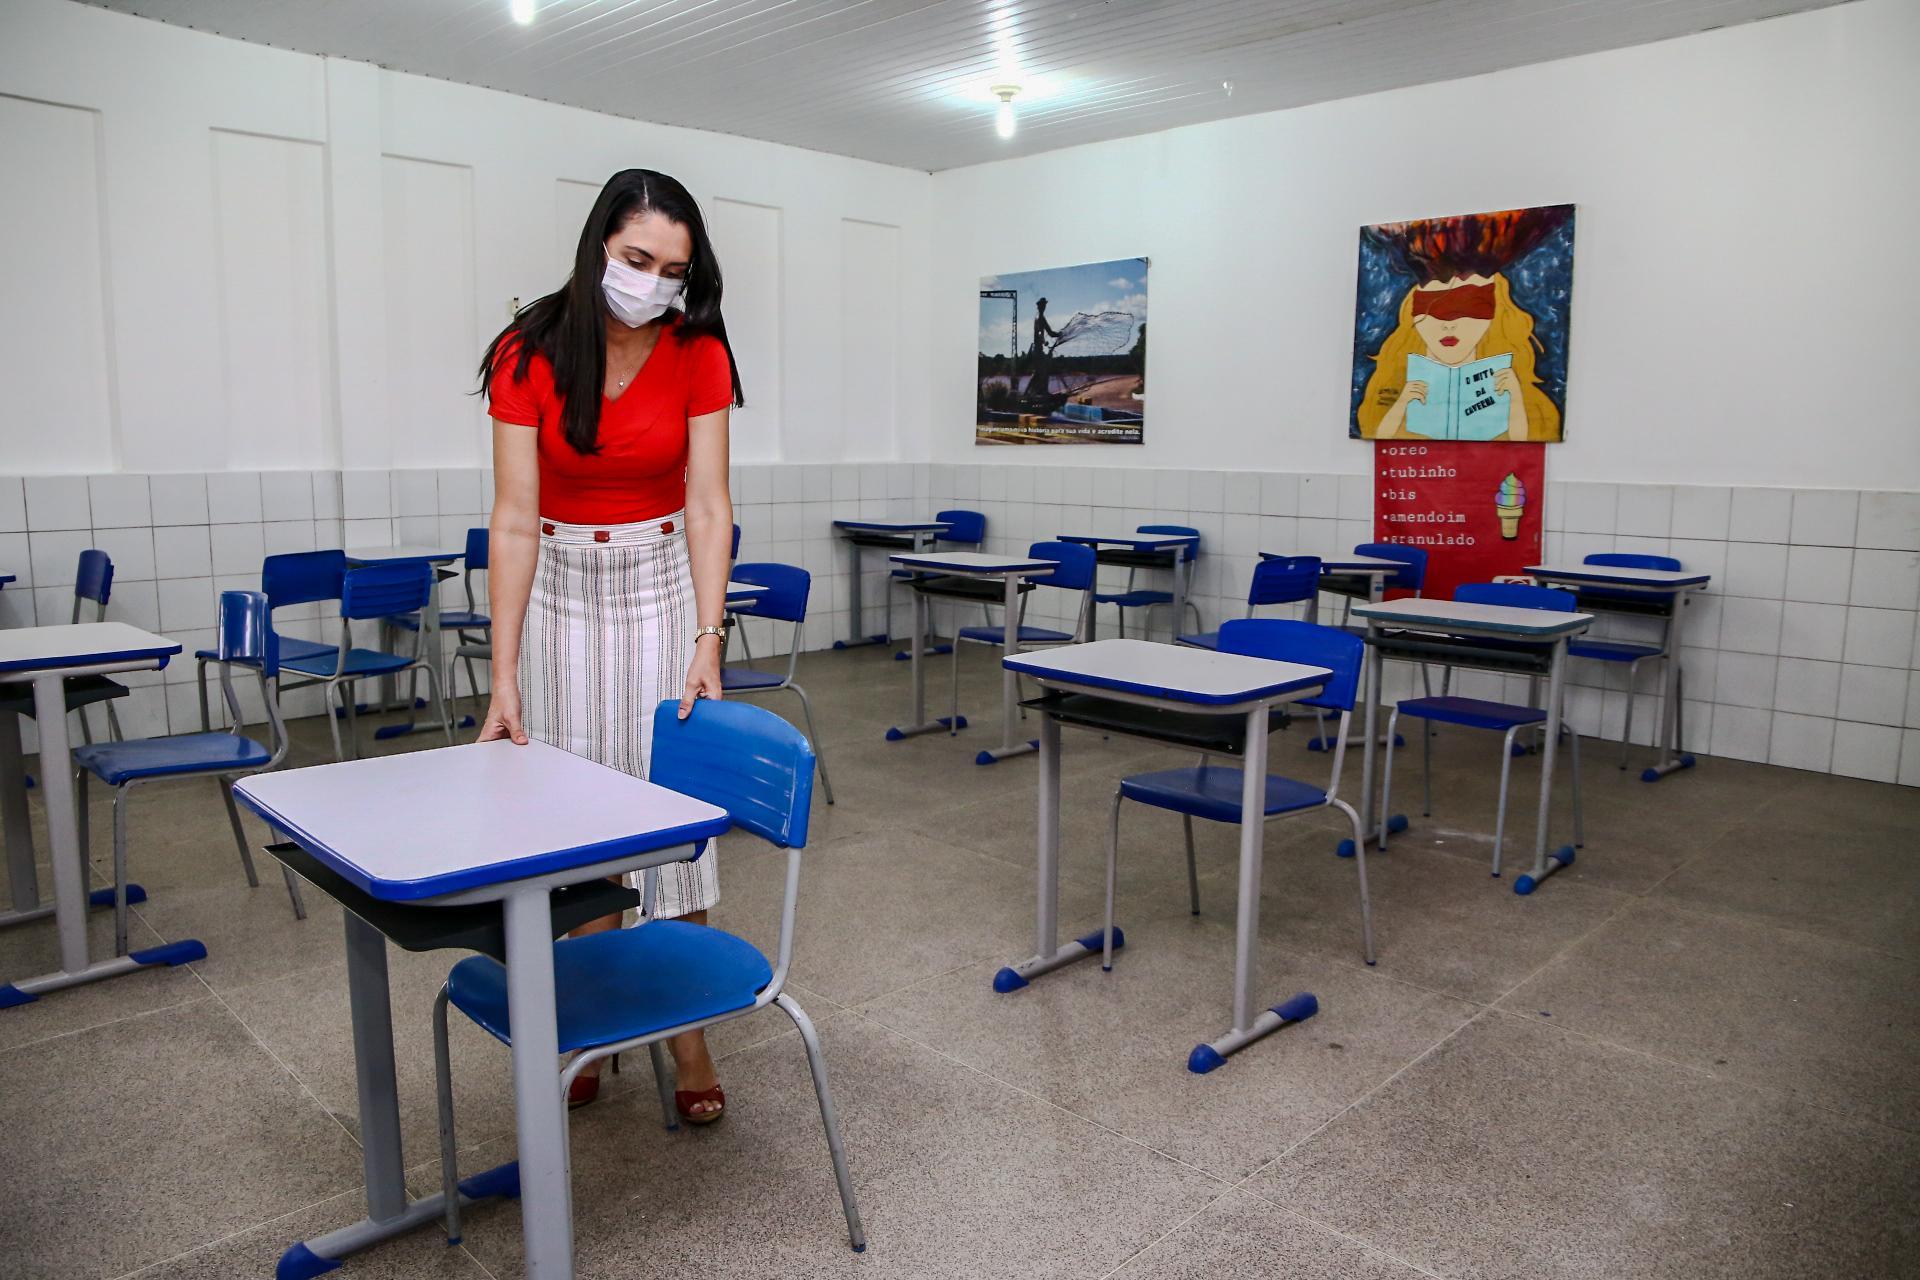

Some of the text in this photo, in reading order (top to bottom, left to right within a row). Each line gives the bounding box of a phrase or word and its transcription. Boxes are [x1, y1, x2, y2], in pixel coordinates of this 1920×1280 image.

[1476, 386, 1486, 397] DA
[1464, 396, 1496, 416] CAVERNA
[1389, 446, 1428, 456] oreo
[1389, 466, 1456, 478] tubinho
[1389, 489, 1416, 500] bis
[1390, 511, 1466, 523] amendoim
[1391, 533, 1475, 545] granulado
